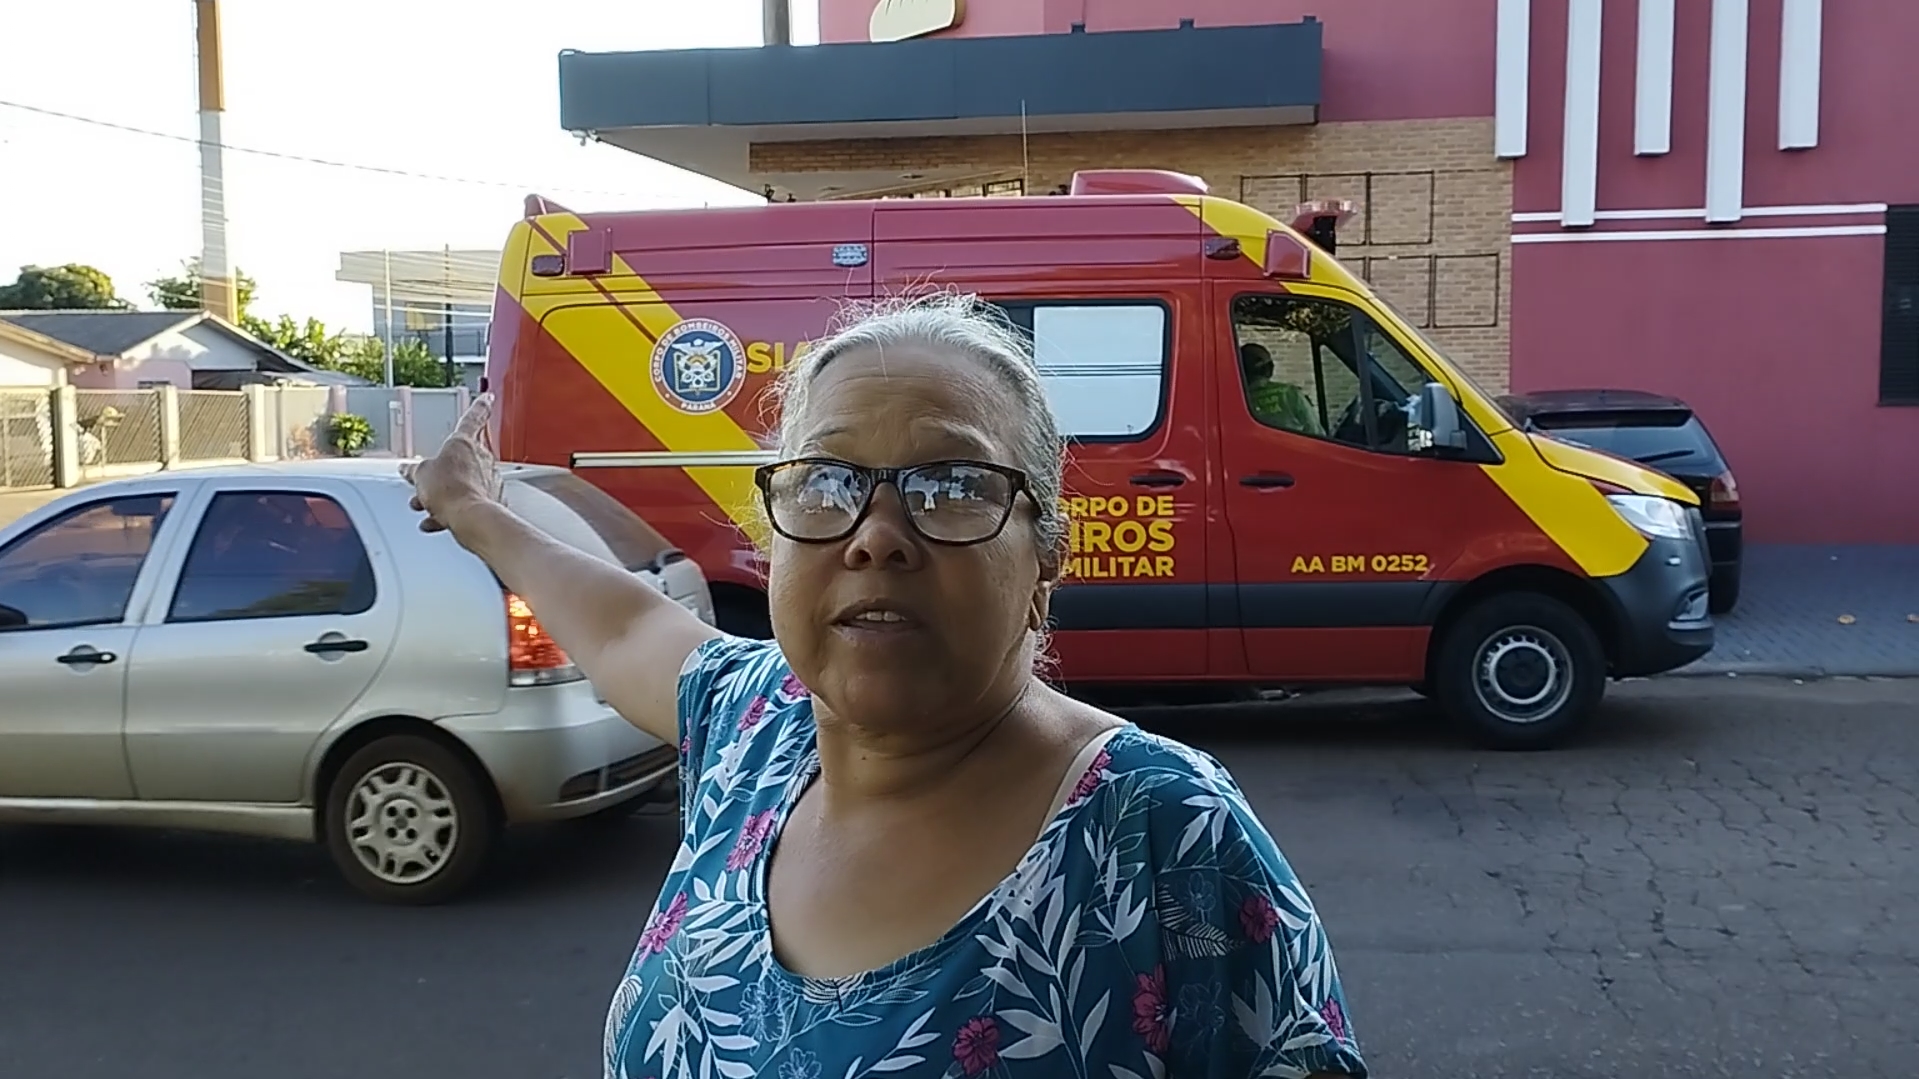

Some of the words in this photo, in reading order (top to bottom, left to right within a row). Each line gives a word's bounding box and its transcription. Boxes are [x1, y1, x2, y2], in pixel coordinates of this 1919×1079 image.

[1136, 495, 1175, 516] DE
[1070, 520, 1175, 552] IROS
[1291, 555, 1326, 573] AA
[1331, 555, 1366, 572] BM
[1371, 554, 1428, 572] 0252
